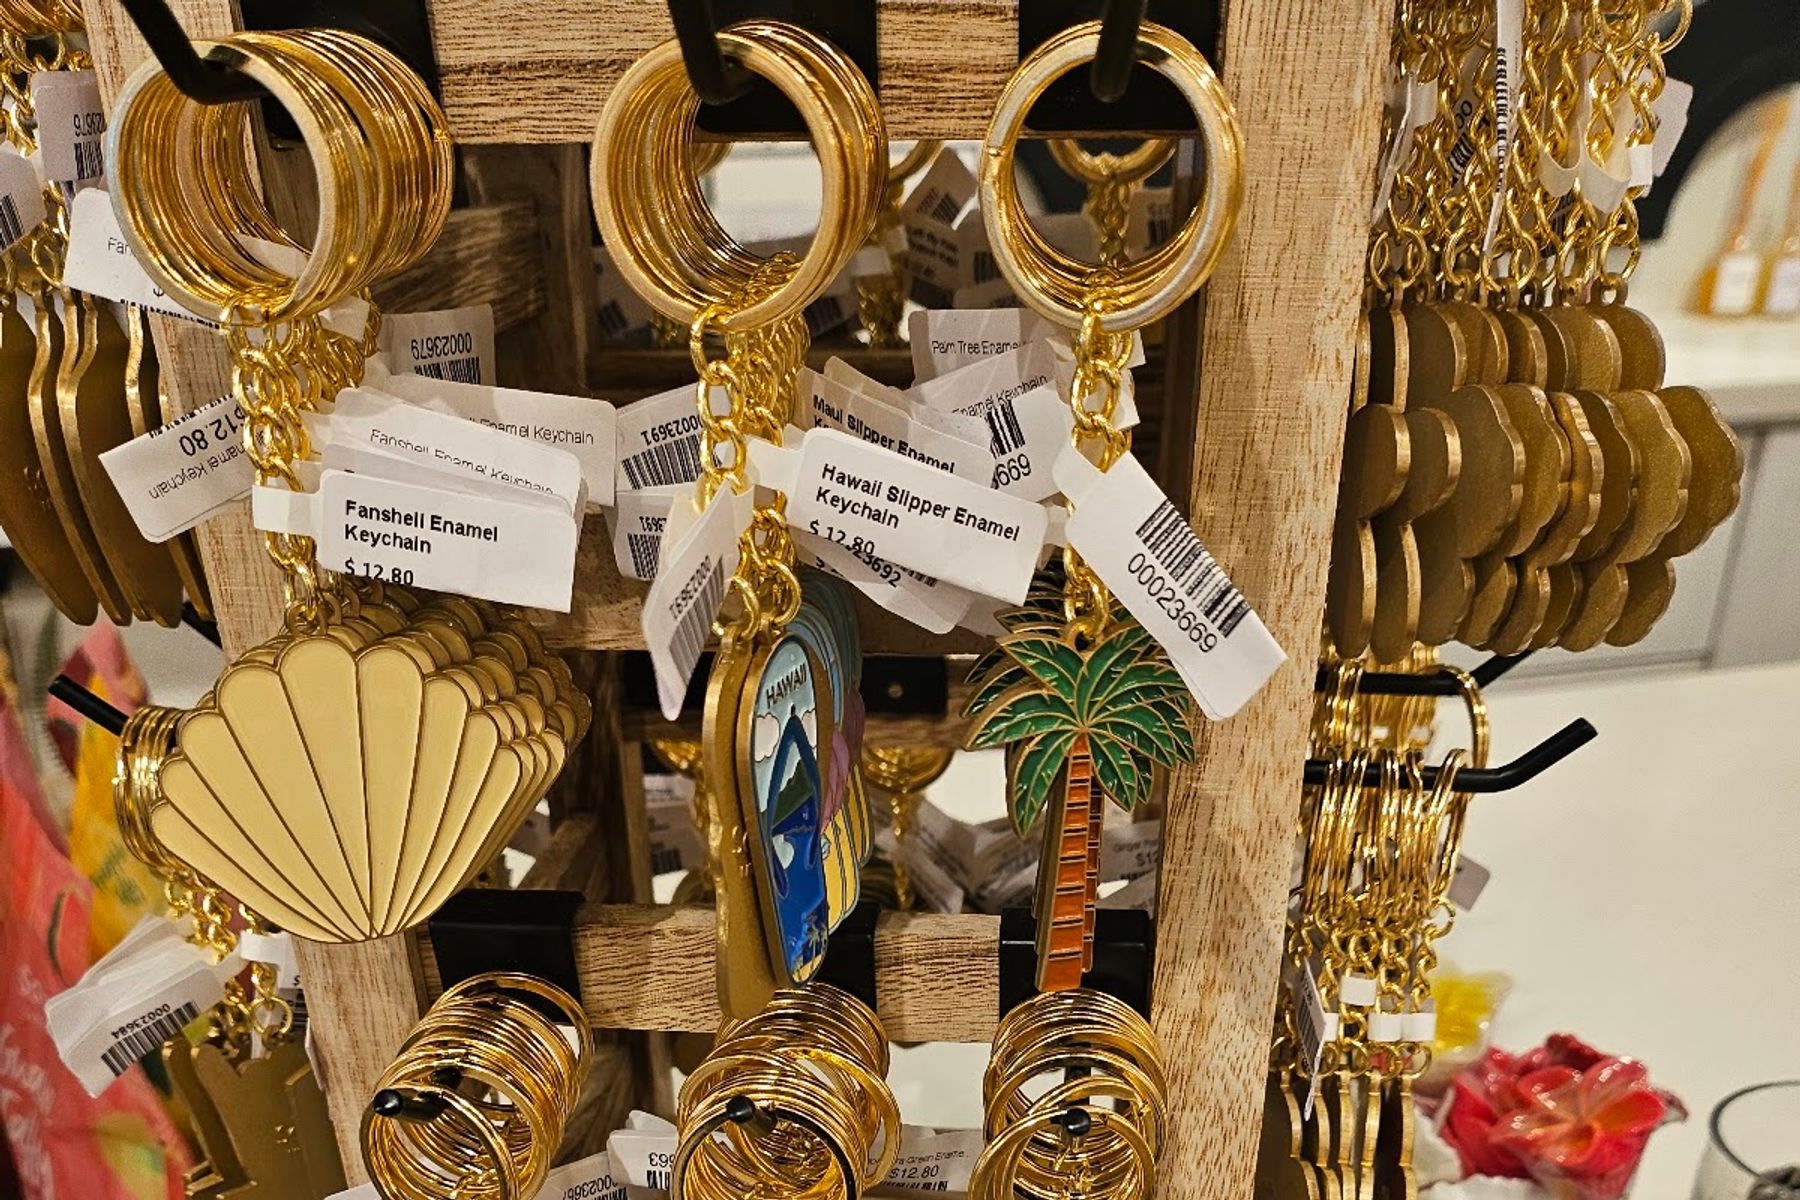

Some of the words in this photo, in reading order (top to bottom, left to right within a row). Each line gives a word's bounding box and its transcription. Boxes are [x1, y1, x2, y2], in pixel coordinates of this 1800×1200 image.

[957, 340, 980, 355] Tree
[534, 425, 594, 446] Keychain
[847, 413, 895, 449] Slipper
[345, 499, 425, 530] Fanshell
[430, 515, 498, 542] Enamel
[815, 486, 900, 530] Keychain
[821, 463, 883, 498] Hawaii
[886, 485, 951, 519] Slipper
[953, 505, 1020, 542] Enamel
[344, 524, 432, 554] Keychain
[344, 557, 355, 577] $
[363, 562, 414, 586] 12.80
[1127, 553, 1218, 653] 00023669
[766, 663, 807, 709] HAWAII
[889, 1165, 939, 1179] $12.80
